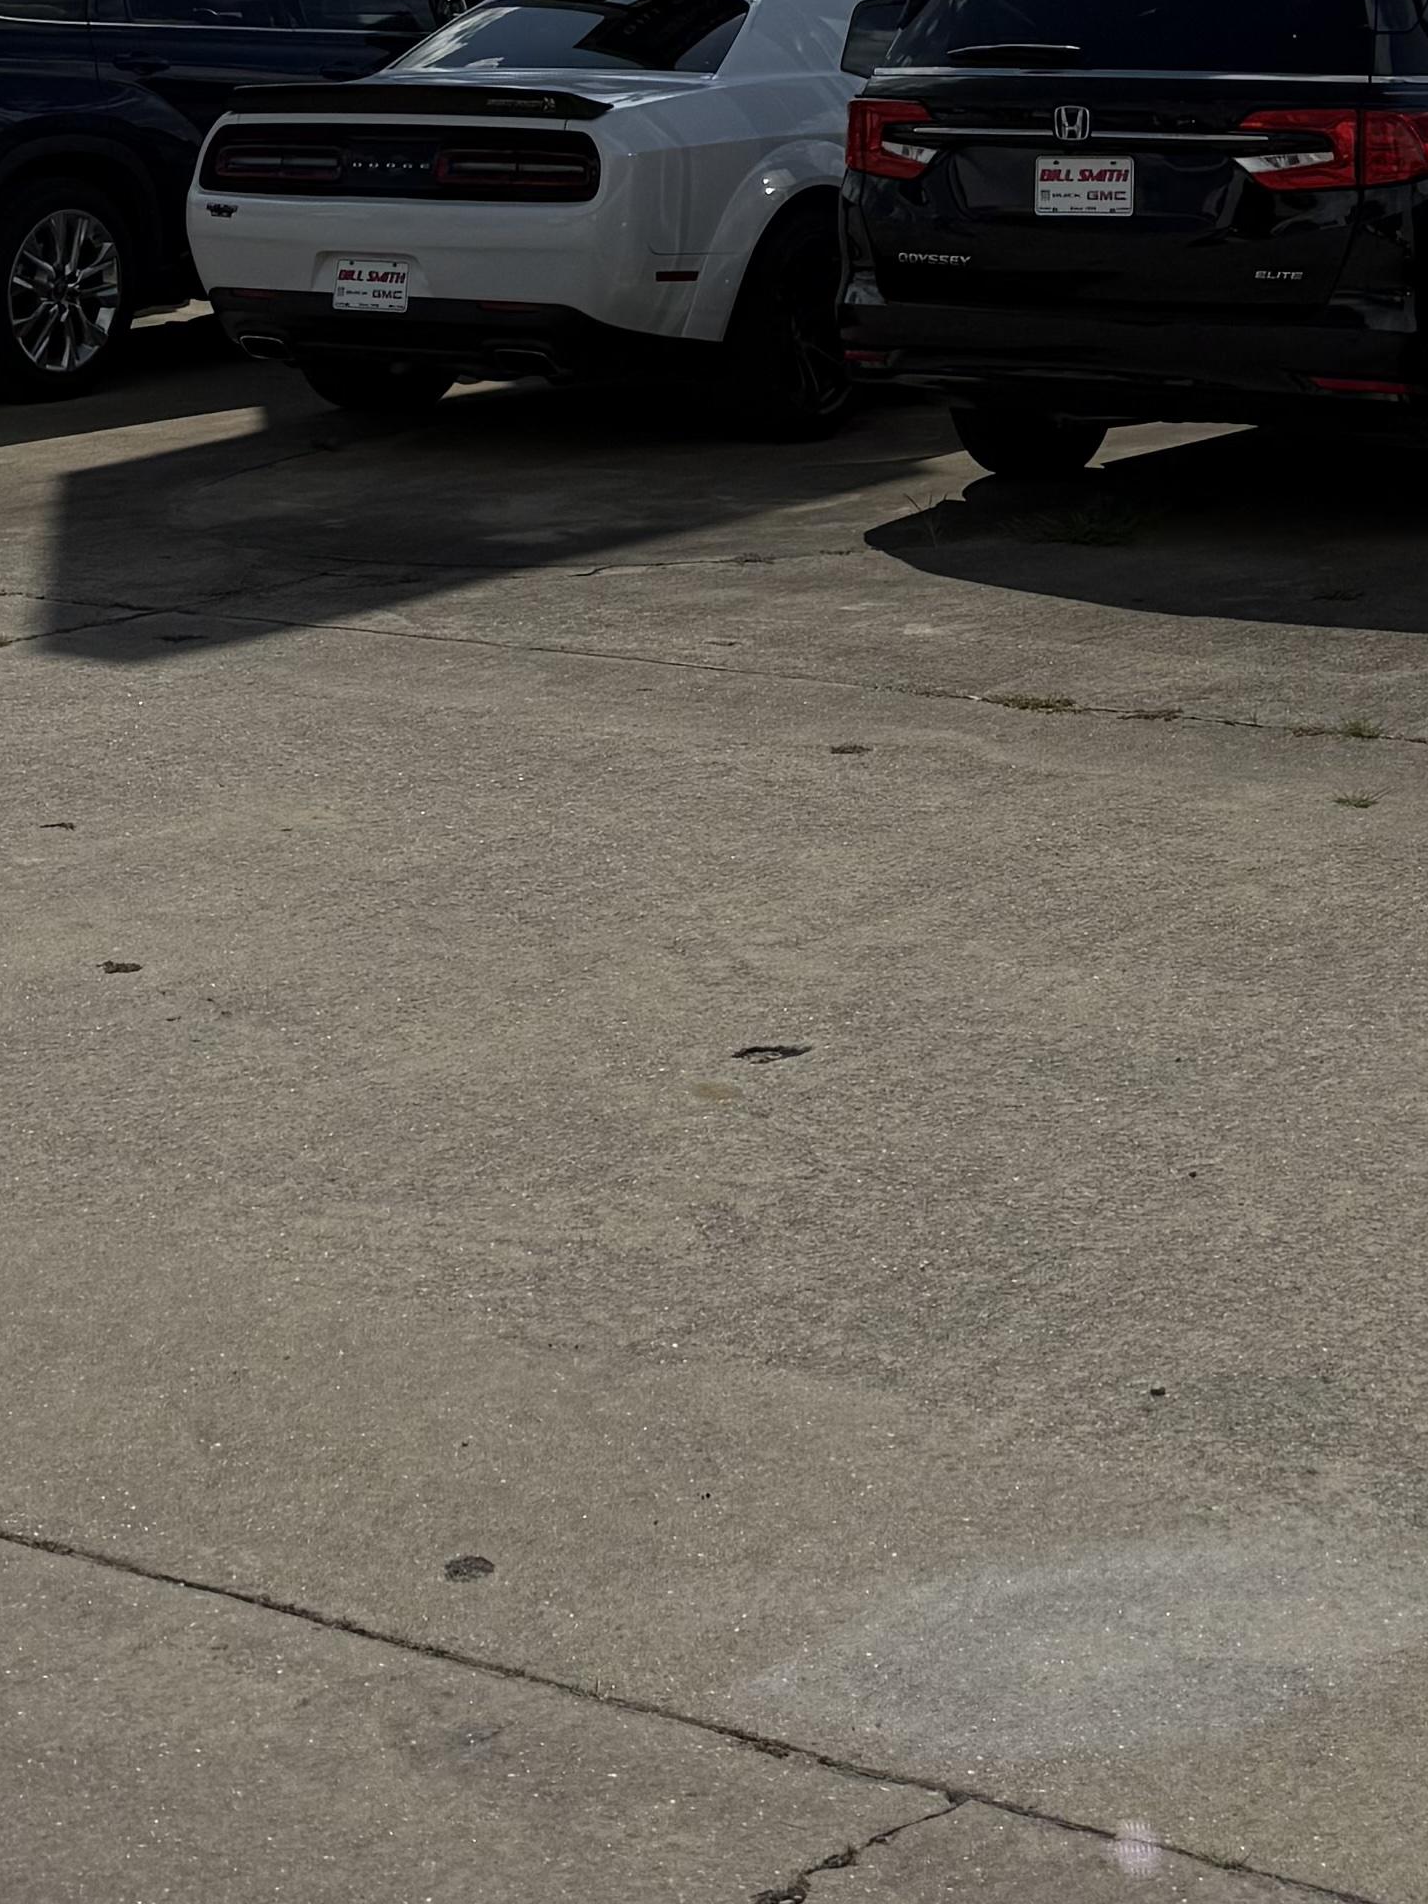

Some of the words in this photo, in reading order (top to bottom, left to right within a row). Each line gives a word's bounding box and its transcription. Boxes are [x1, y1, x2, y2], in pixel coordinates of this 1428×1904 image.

[352, 161, 431, 170] DODGE
[1039, 169, 1074, 181] BILL
[1077, 169, 1130, 182] SMITH
[1087, 191, 1127, 200] GMC
[898, 252, 972, 265] ODYSSEY
[338, 270, 364, 281] BILL
[366, 271, 406, 283] SMITH
[1254, 270, 1304, 280] ELITE
[372, 290, 403, 299] GMC
